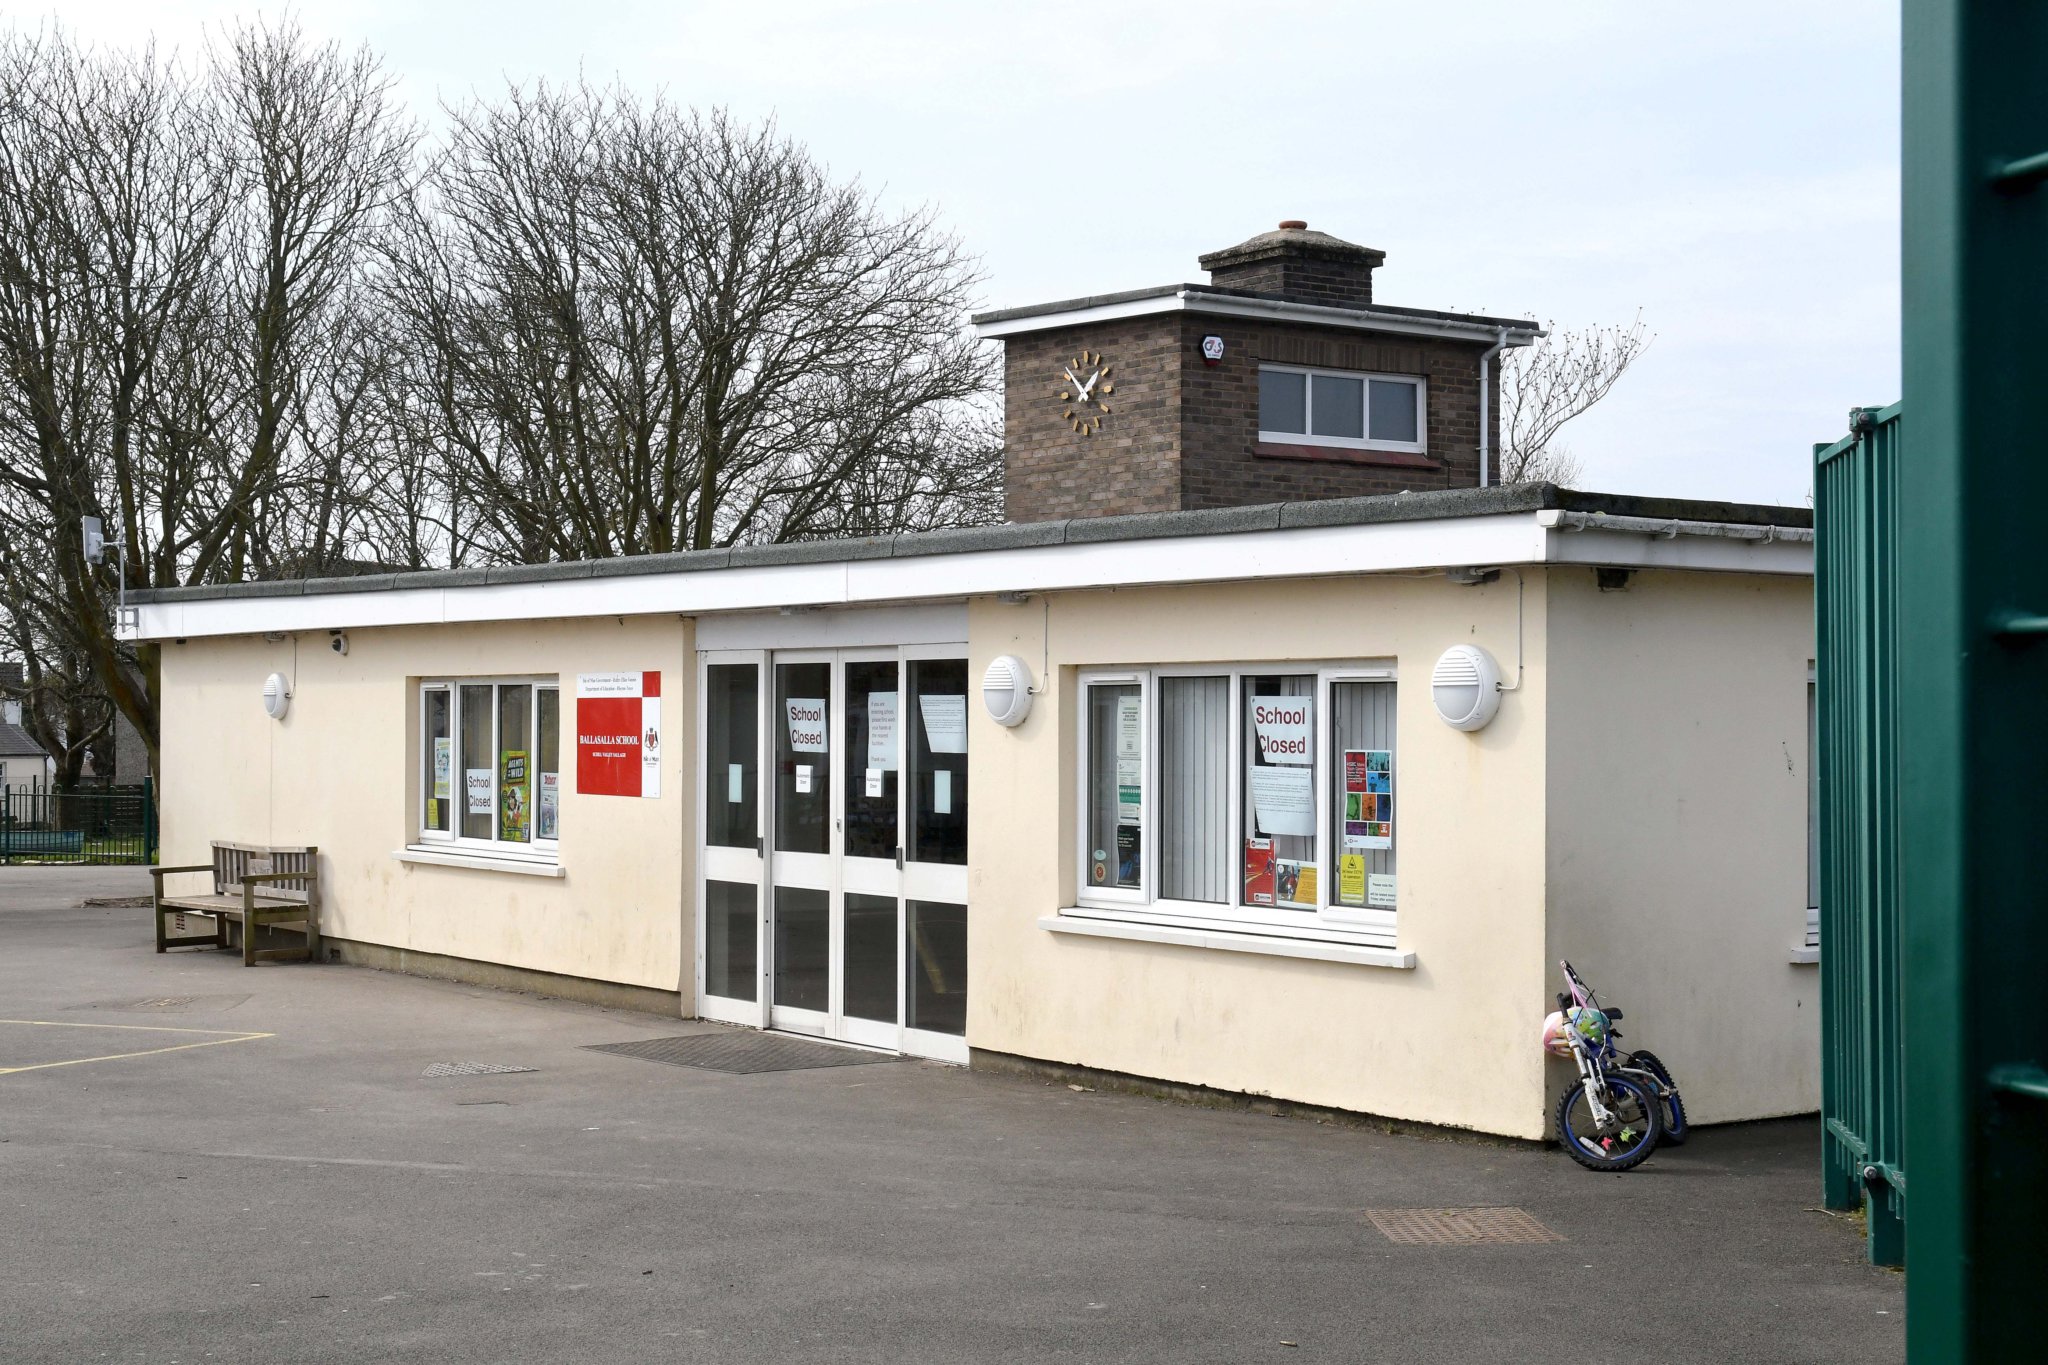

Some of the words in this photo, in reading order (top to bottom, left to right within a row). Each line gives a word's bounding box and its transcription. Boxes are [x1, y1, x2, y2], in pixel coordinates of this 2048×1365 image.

[791, 706, 821, 721] School
[1256, 706, 1305, 724] School
[580, 735, 615, 744] BALLASALLA
[616, 735, 639, 745] SCHOOL
[792, 729, 822, 745] Closed
[1259, 735, 1305, 754] Closed
[468, 775, 491, 788] School
[470, 794, 491, 807] Closed
